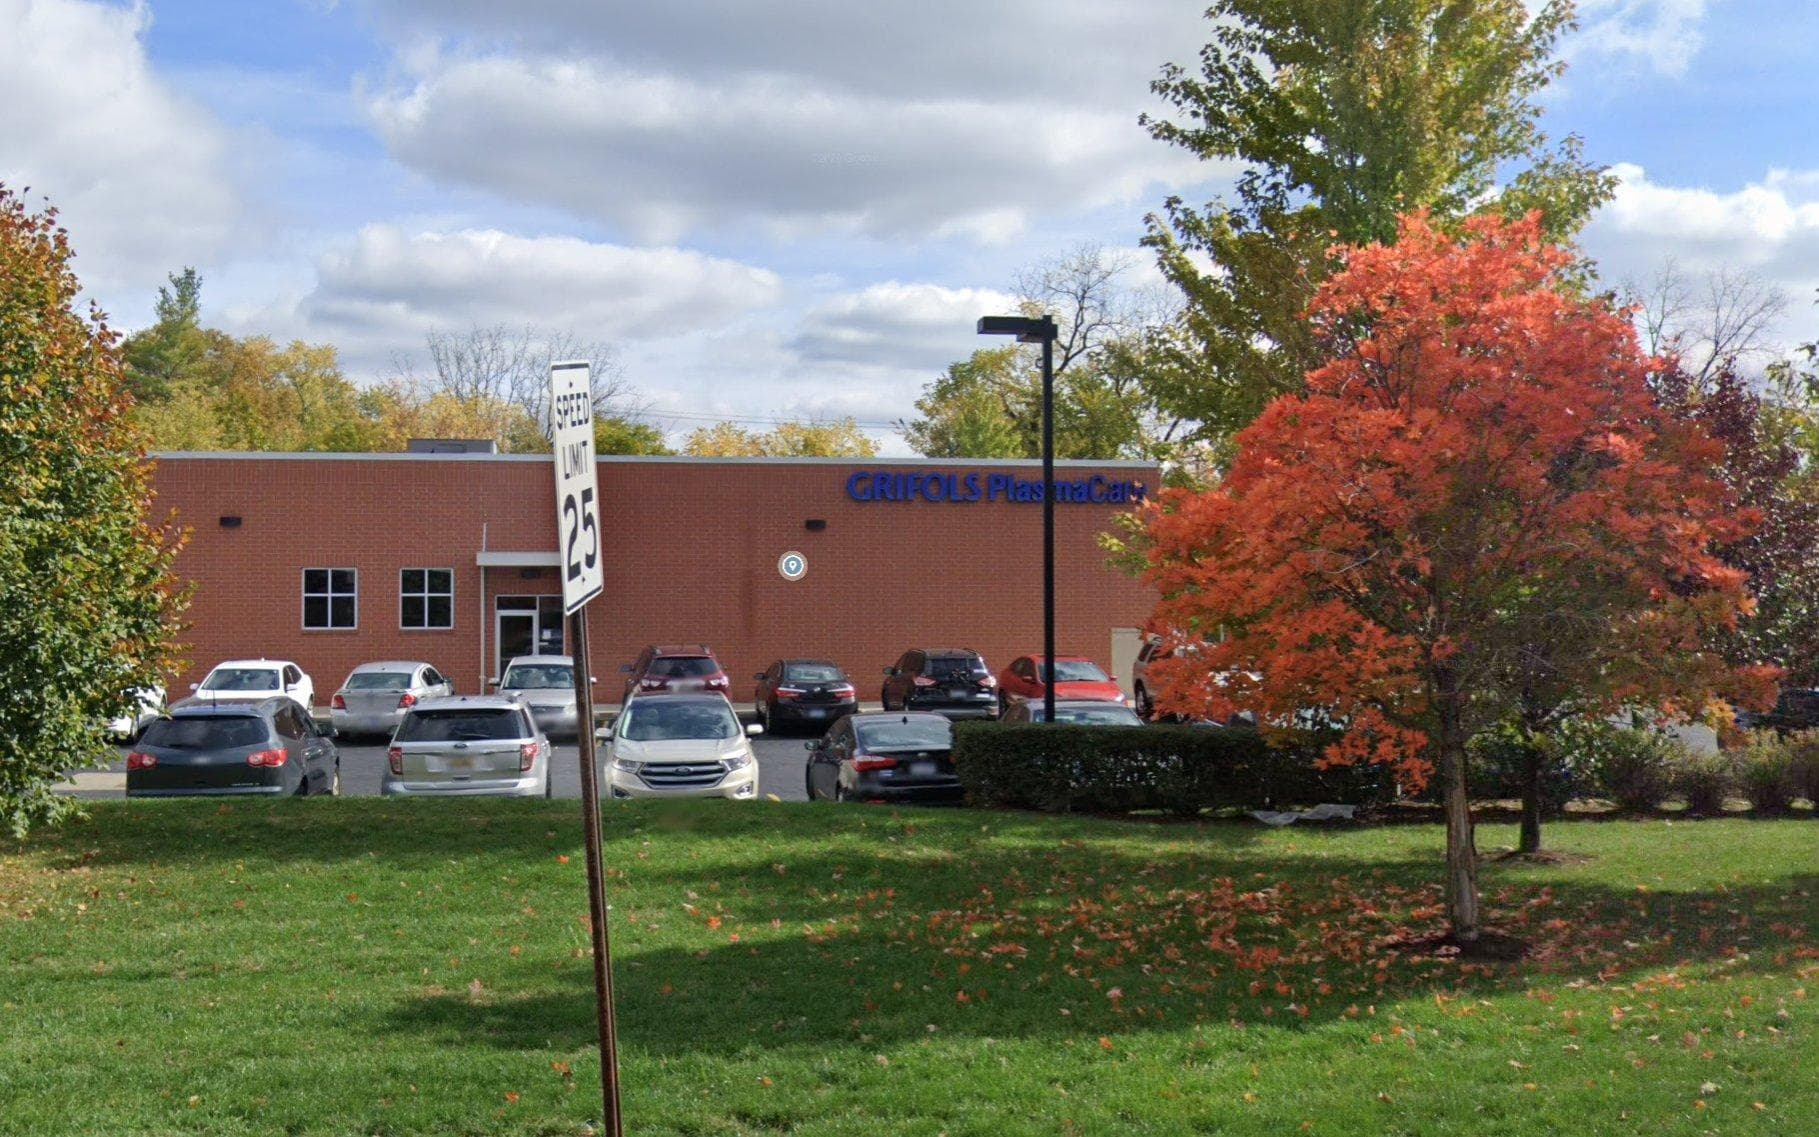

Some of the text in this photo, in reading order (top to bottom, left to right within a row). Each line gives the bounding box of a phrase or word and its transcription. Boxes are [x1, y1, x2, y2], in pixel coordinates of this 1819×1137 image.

[556, 392, 590, 430] SPEED
[563, 440, 589, 480] LIMIT
[847, 471, 983, 503] GRIFOLS
[563, 487, 598, 582] 25
